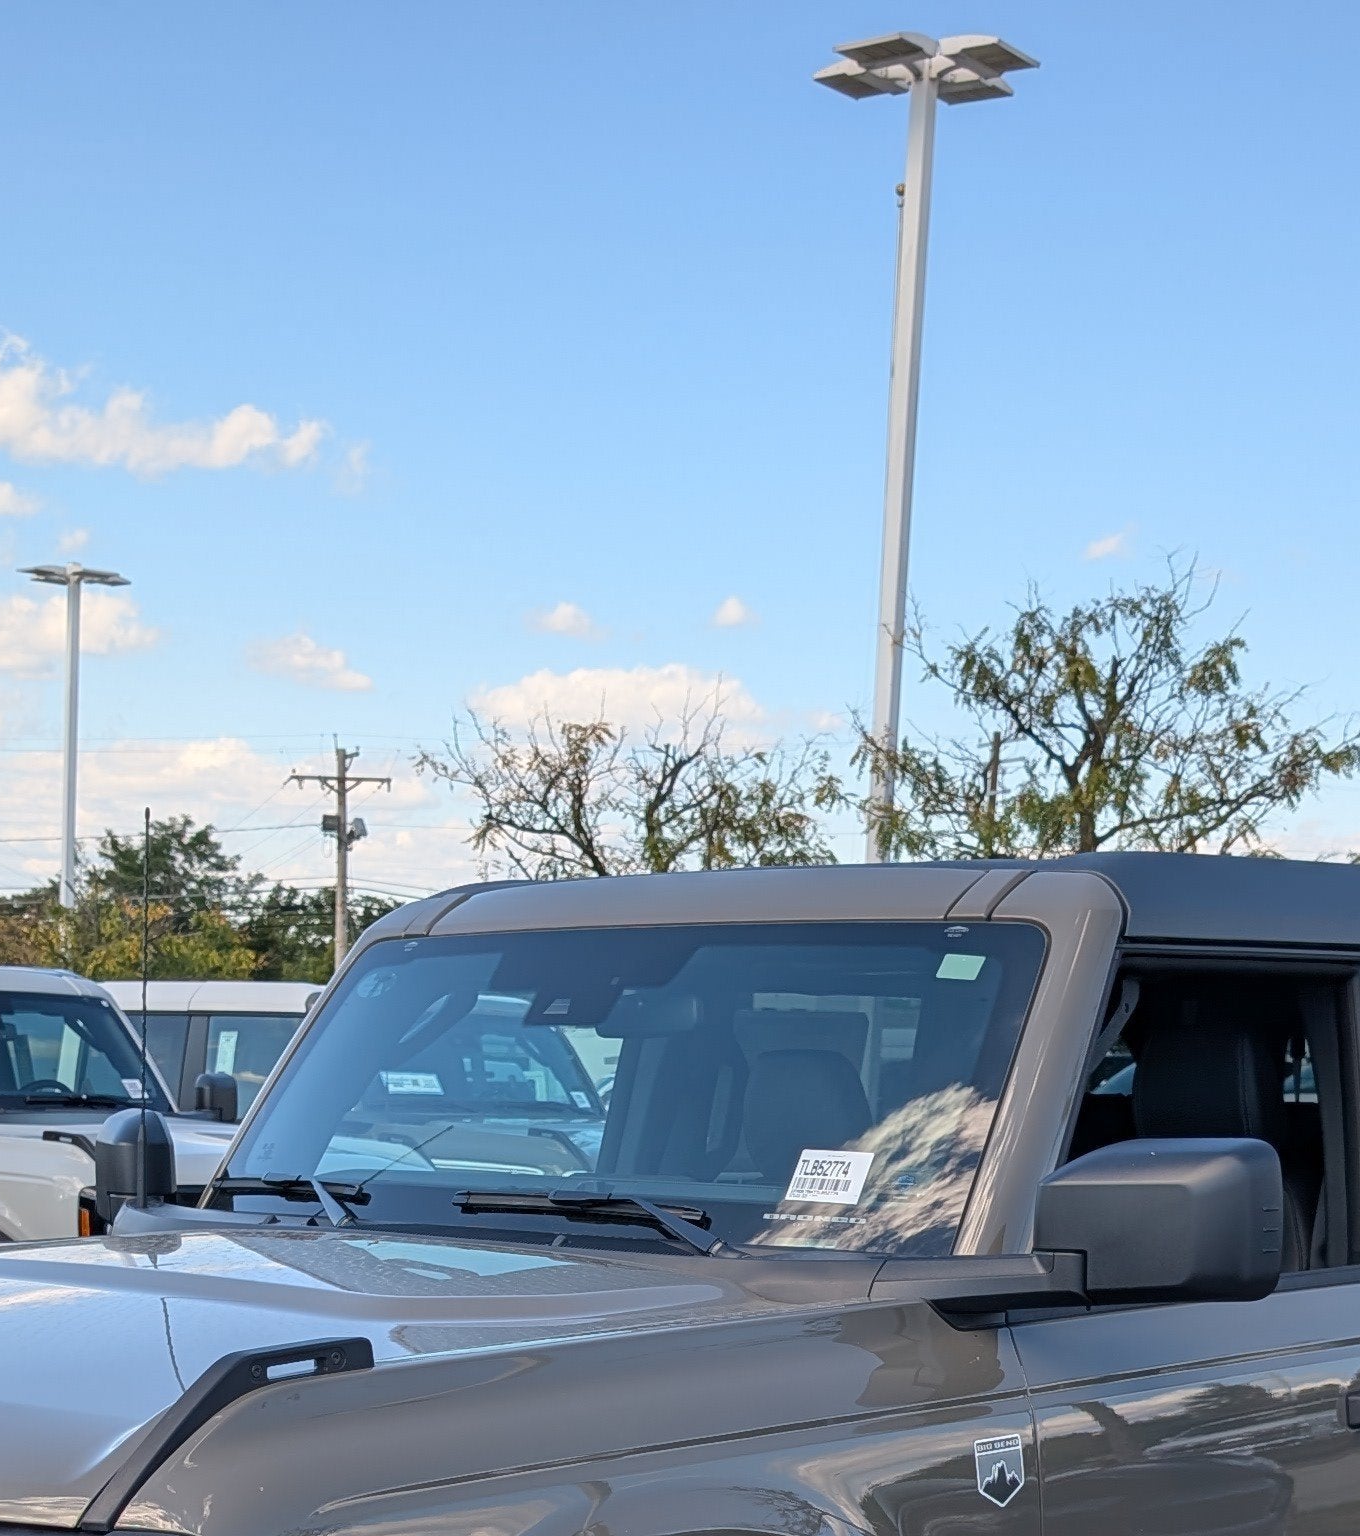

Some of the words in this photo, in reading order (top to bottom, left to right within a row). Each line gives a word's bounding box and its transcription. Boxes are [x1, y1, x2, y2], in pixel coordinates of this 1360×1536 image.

[799, 1159, 852, 1178] TLB52774
[977, 1444, 993, 1452] BIG
[994, 1439, 1019, 1448] BEND
